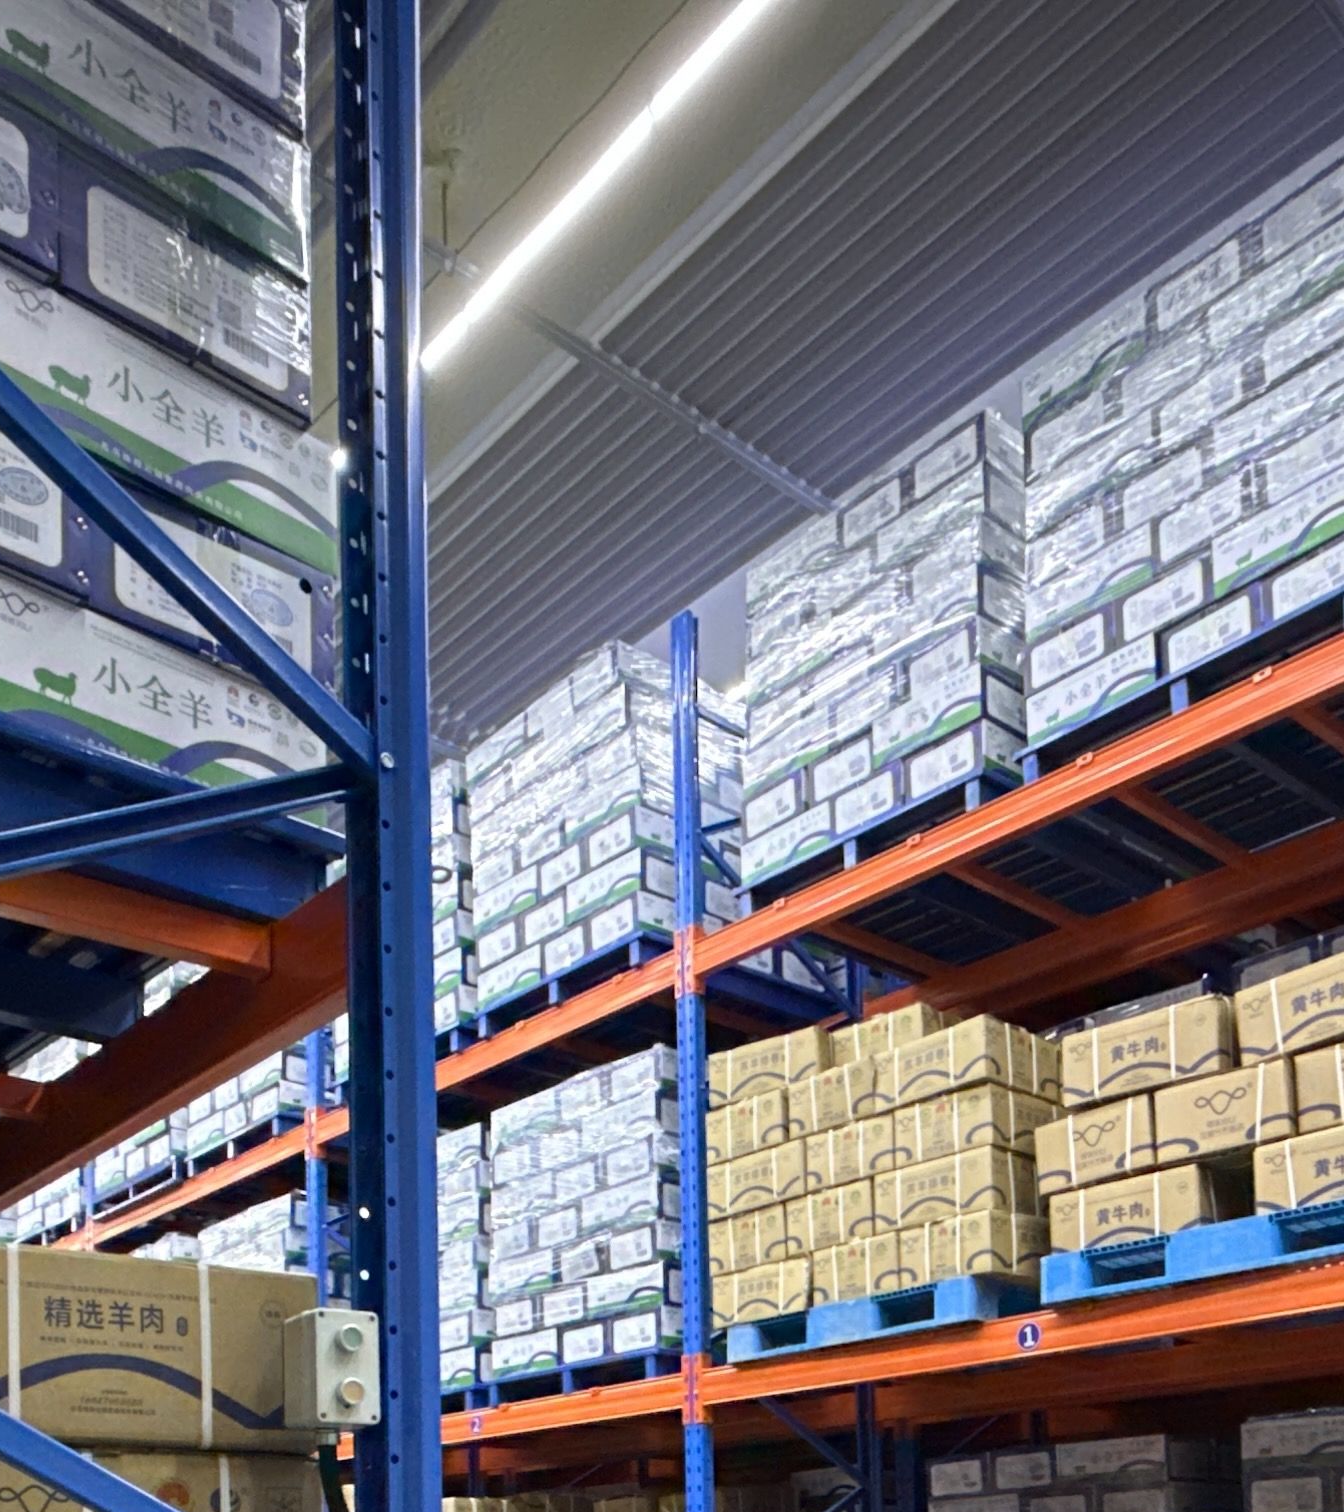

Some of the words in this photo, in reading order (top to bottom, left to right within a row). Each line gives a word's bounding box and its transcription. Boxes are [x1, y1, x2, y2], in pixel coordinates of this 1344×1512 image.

[67, 38, 194, 134] 小全羊
[107, 365, 226, 449] 小全羊
[93, 656, 214, 730] 小全羊
[1111, 1036, 1159, 1064] 黄牛肉
[1096, 1200, 1143, 1226] 黄牛肉
[44, 1296, 165, 1335] 精选羊肉
[1021, 1326, 1035, 1347] 1
